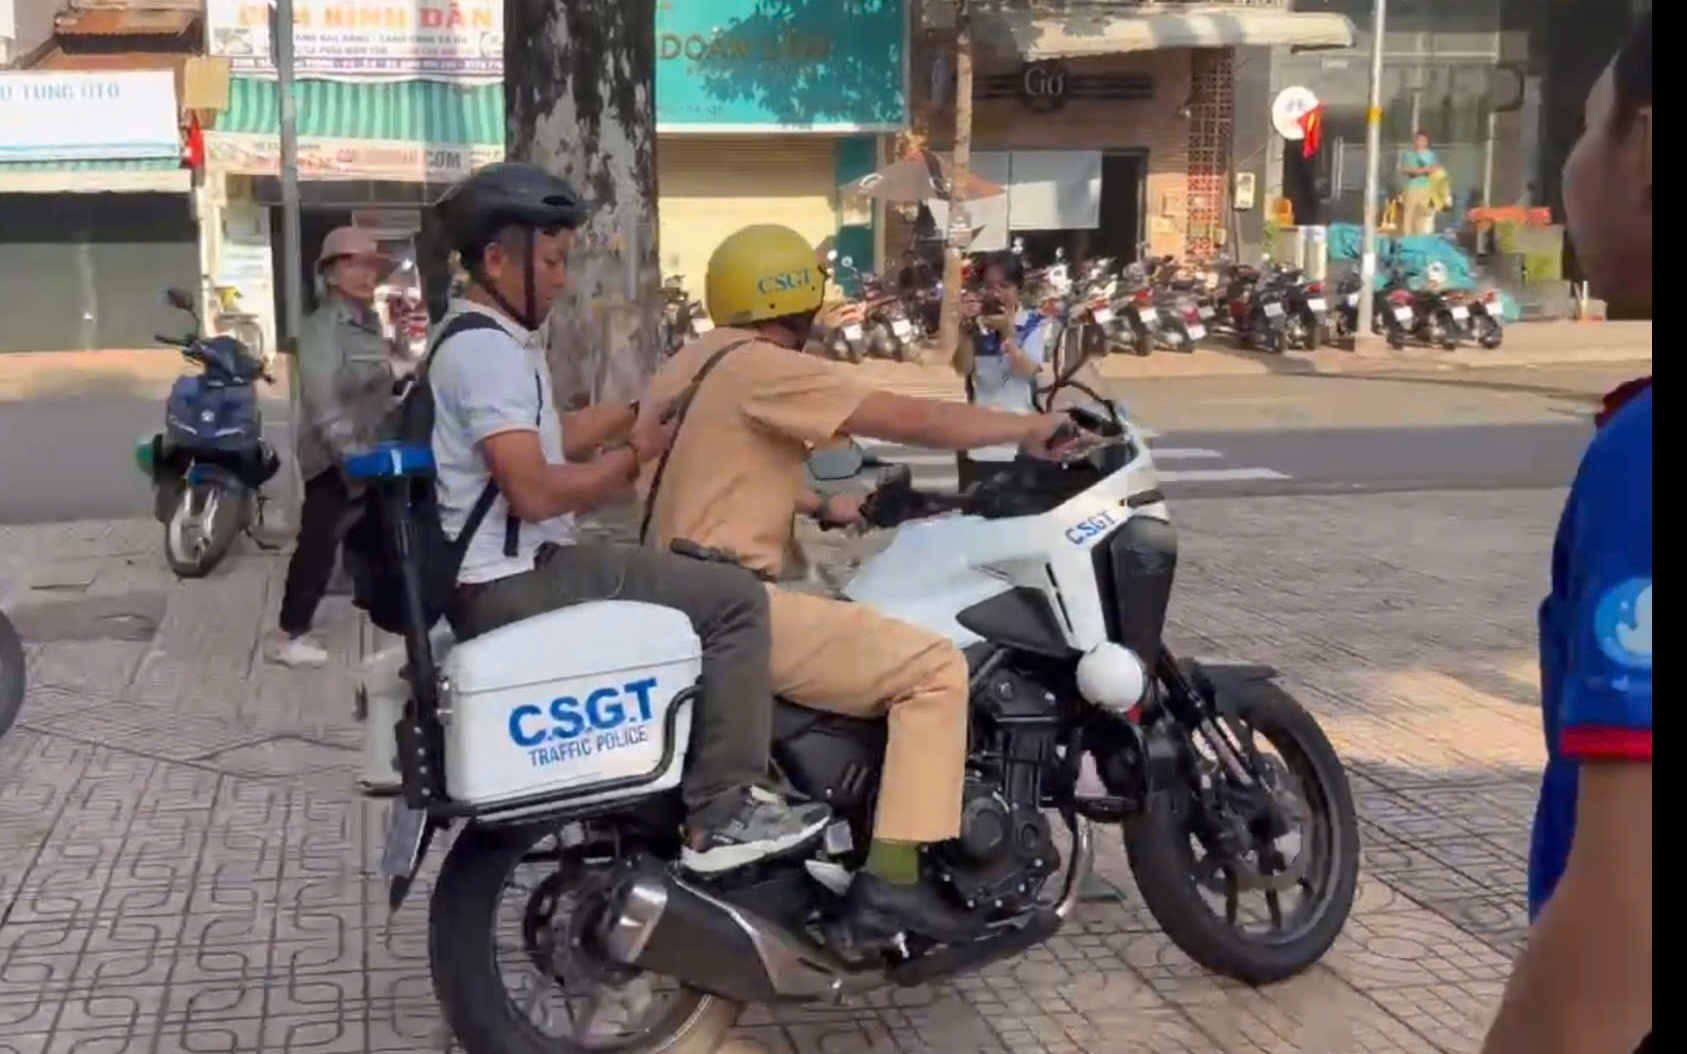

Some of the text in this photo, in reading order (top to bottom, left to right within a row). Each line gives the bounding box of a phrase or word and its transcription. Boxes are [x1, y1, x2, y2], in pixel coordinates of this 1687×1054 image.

[758, 268, 812, 295] CSGT
[1065, 511, 1117, 545] CSGT
[529, 724, 649, 767] TRAFFIC POLICE
